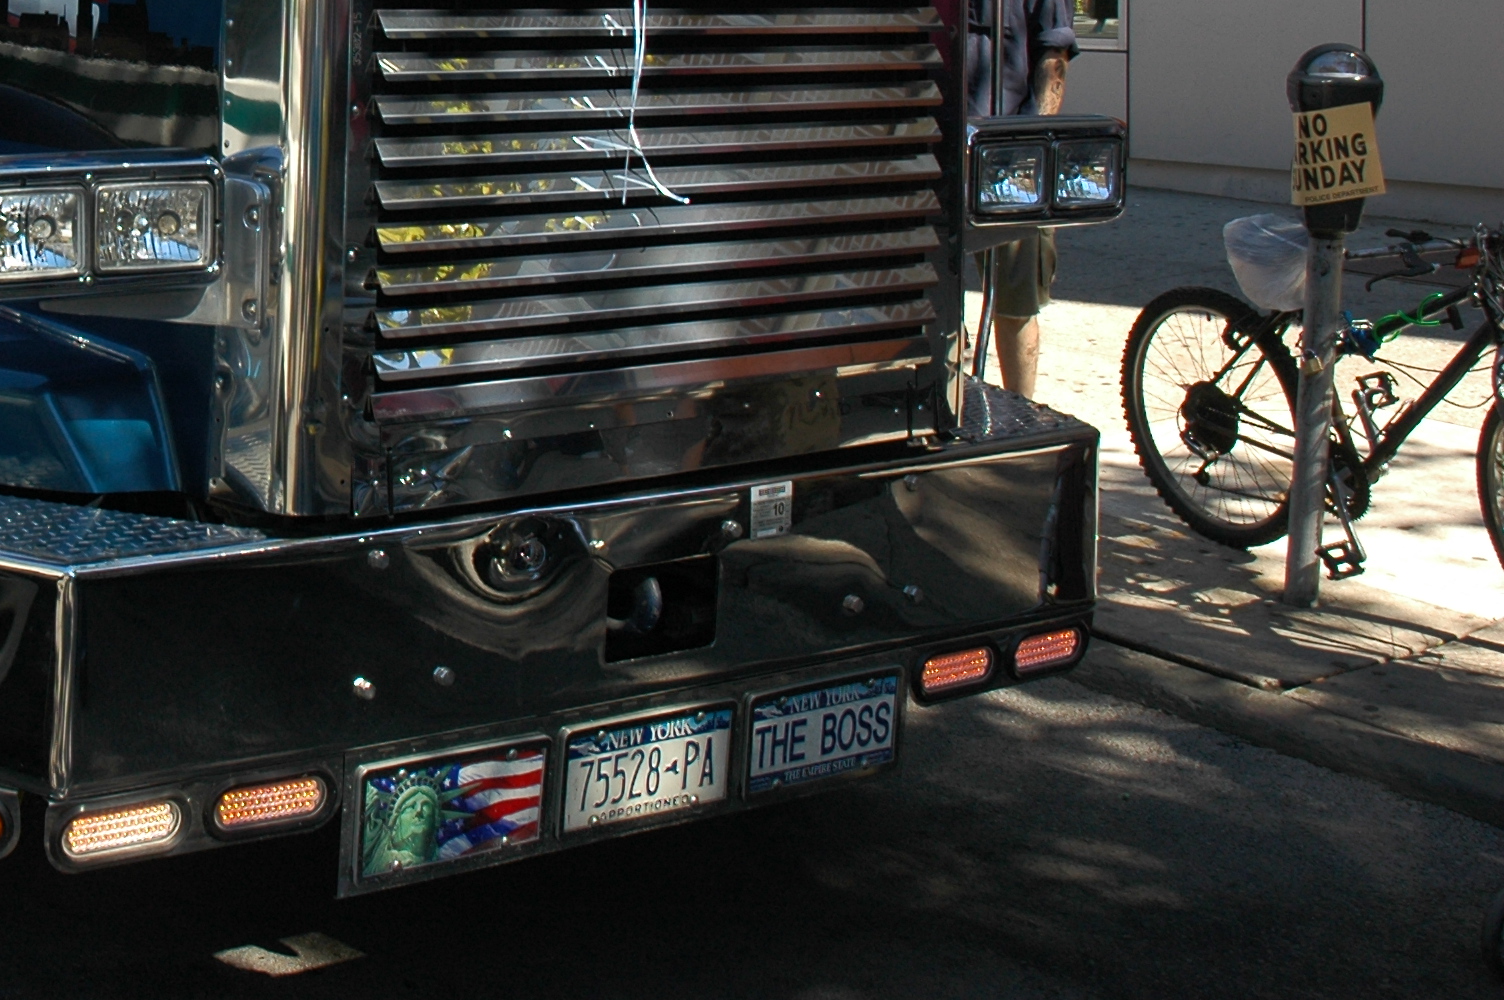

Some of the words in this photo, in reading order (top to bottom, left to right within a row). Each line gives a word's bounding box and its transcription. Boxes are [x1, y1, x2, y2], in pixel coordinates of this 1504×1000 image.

[1297, 113, 1327, 139] NO
[1296, 132, 1368, 165] RKING
[1292, 159, 1366, 192] UNDAY
[1305, 193, 1331, 203] POLICE
[1333, 185, 1379, 200] DEPARTMENT
[774, 502, 785, 516] 10
[791, 691, 822, 715] NEW
[824, 685, 861, 704] YORK
[606, 727, 644, 750] NEW
[650, 719, 693, 742] YORK
[755, 718, 808, 769] THE
[820, 701, 891, 756] BOSS
[784, 768, 801, 782] THE
[802, 762, 832, 778] EMPIRE
[833, 757, 857, 771] STATE
[599, 794, 690, 821] APPORTIONED
